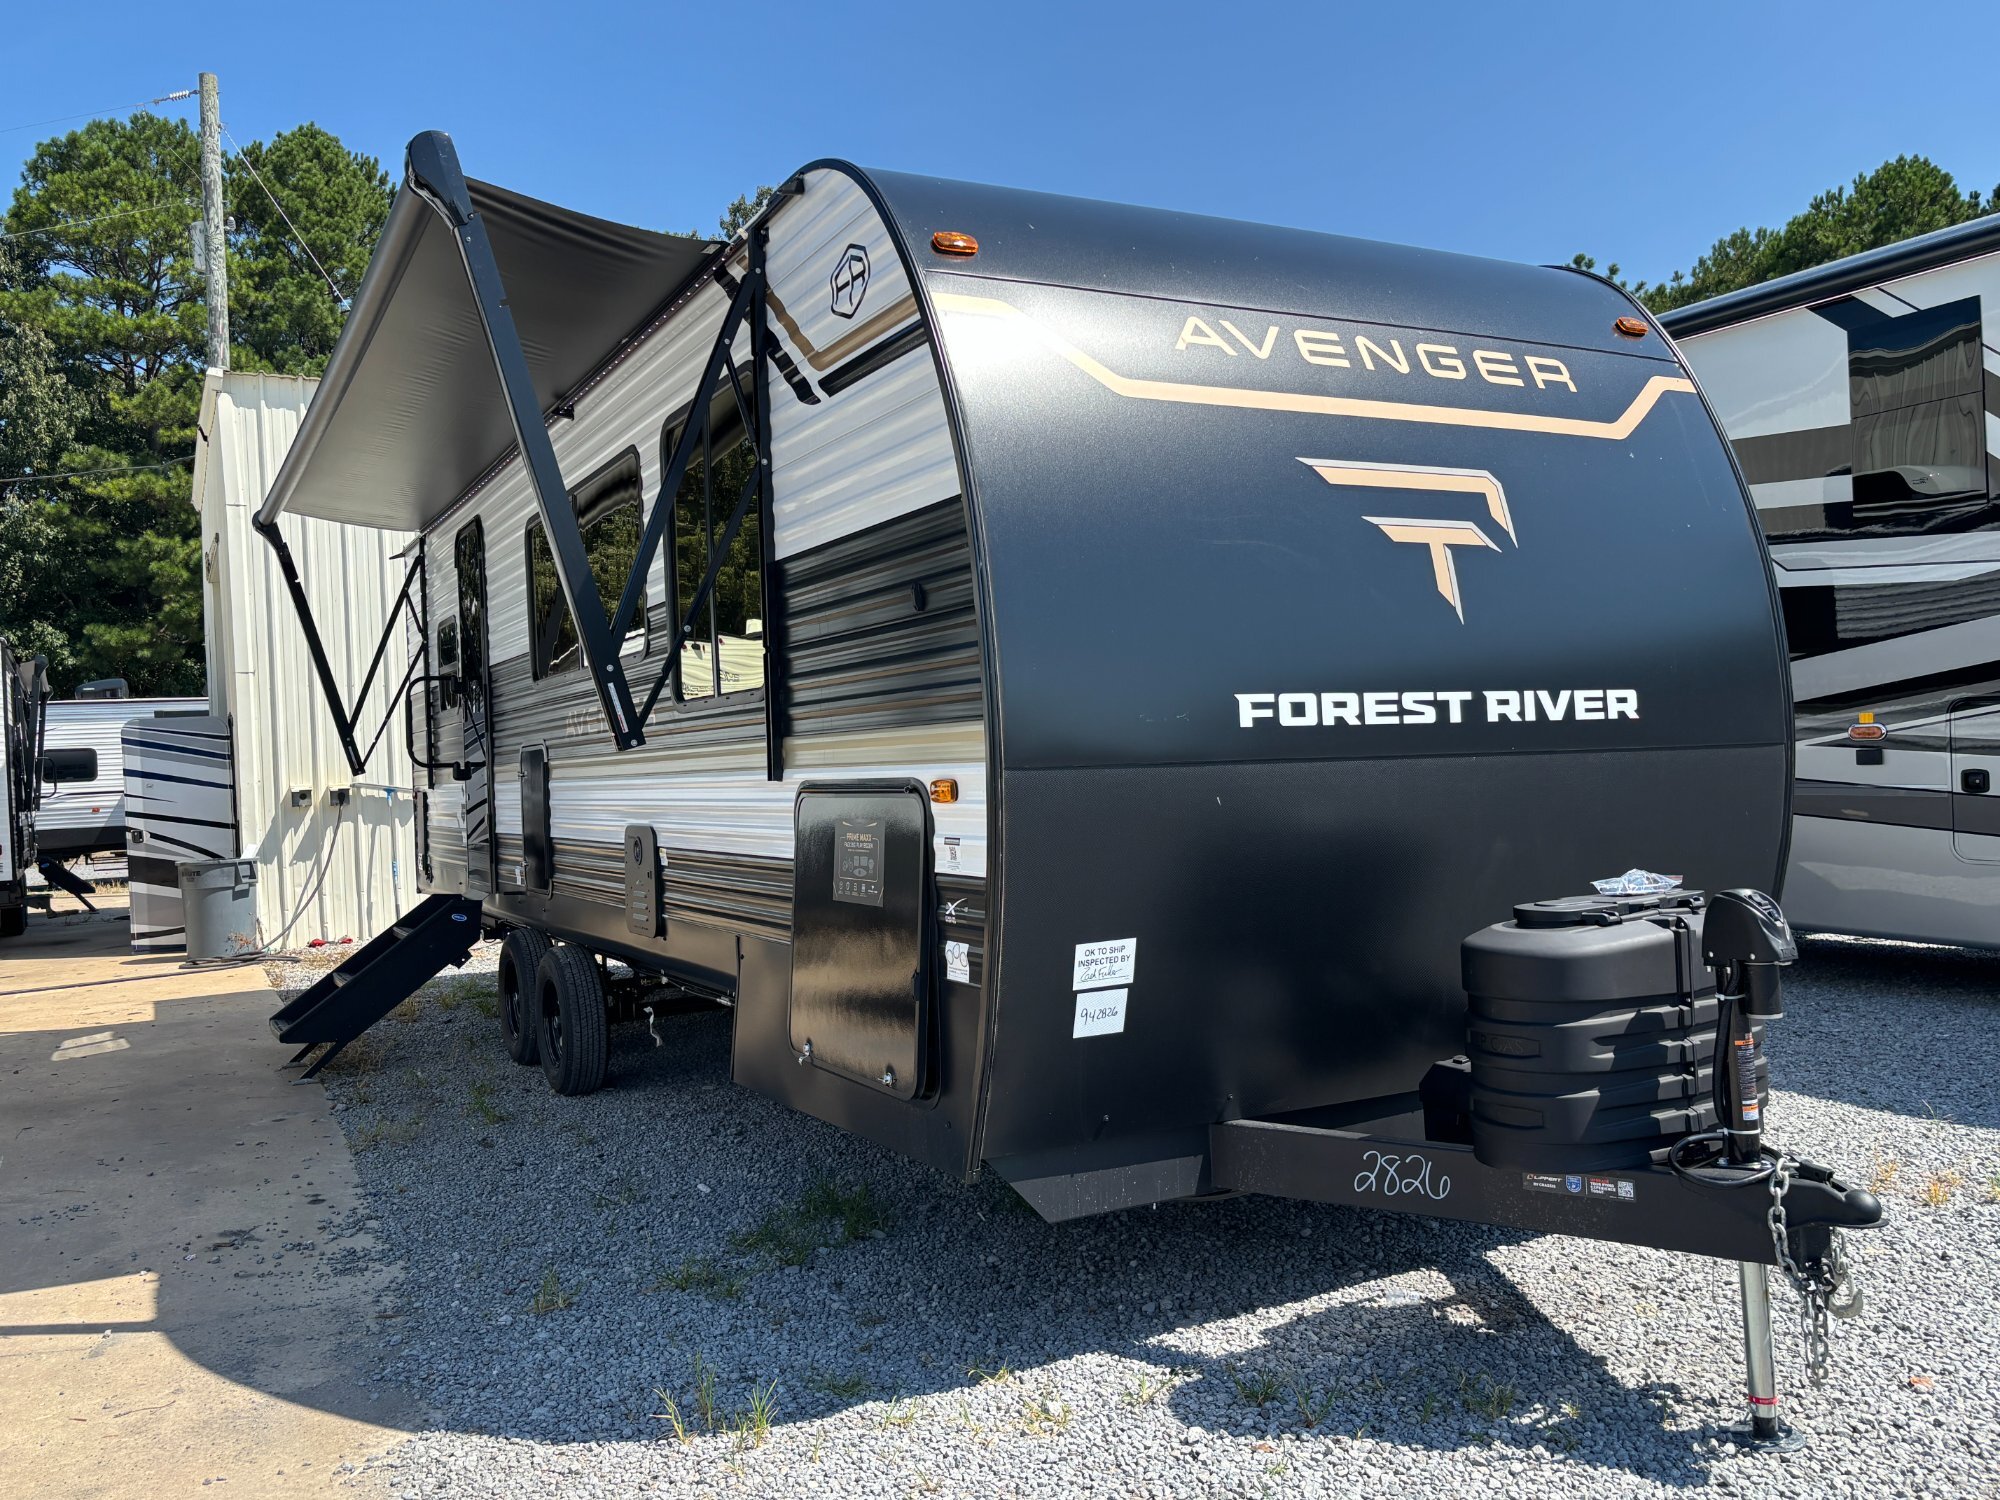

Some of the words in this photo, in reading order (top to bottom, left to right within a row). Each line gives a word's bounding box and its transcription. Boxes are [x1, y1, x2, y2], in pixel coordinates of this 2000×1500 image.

[1175, 316, 1578, 393] AVENGER
[1233, 691, 1472, 729] FOREST
[1482, 688, 1640, 723] RIVER
[1078, 956, 1119, 967] INSPECTED
[1120, 954, 1131, 962] BY
[1084, 948, 1096, 957] OK
[1097, 947, 1108, 955] TO
[1109, 945, 1126, 954] SHIP
[1080, 1006, 1118, 1025] 942826
[1354, 1150, 1451, 1200] 2826
[1533, 1174, 1563, 1183] LIPPERT
